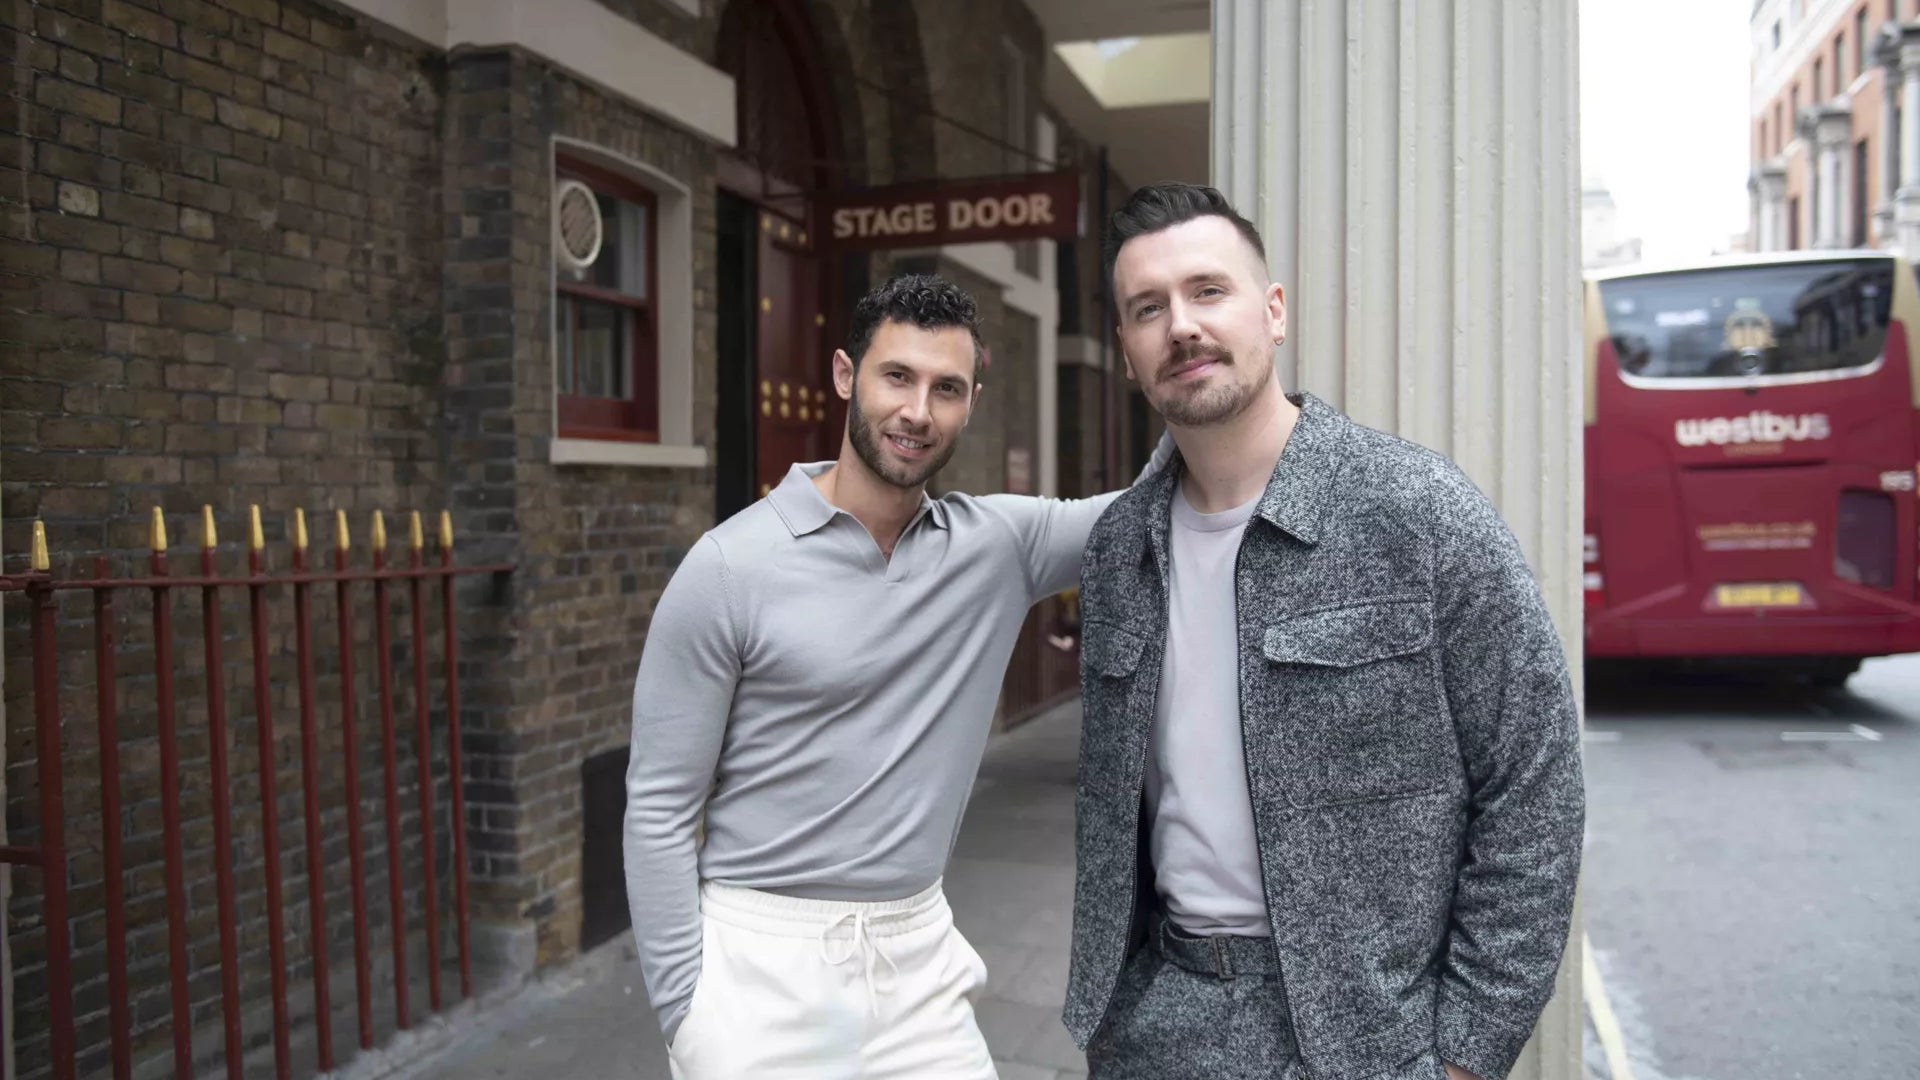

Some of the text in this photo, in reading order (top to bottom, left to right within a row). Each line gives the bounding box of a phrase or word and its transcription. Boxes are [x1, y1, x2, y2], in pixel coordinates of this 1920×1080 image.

[833, 193, 1055, 238] STAGE DOOR
[1675, 410, 1830, 447] westbus
